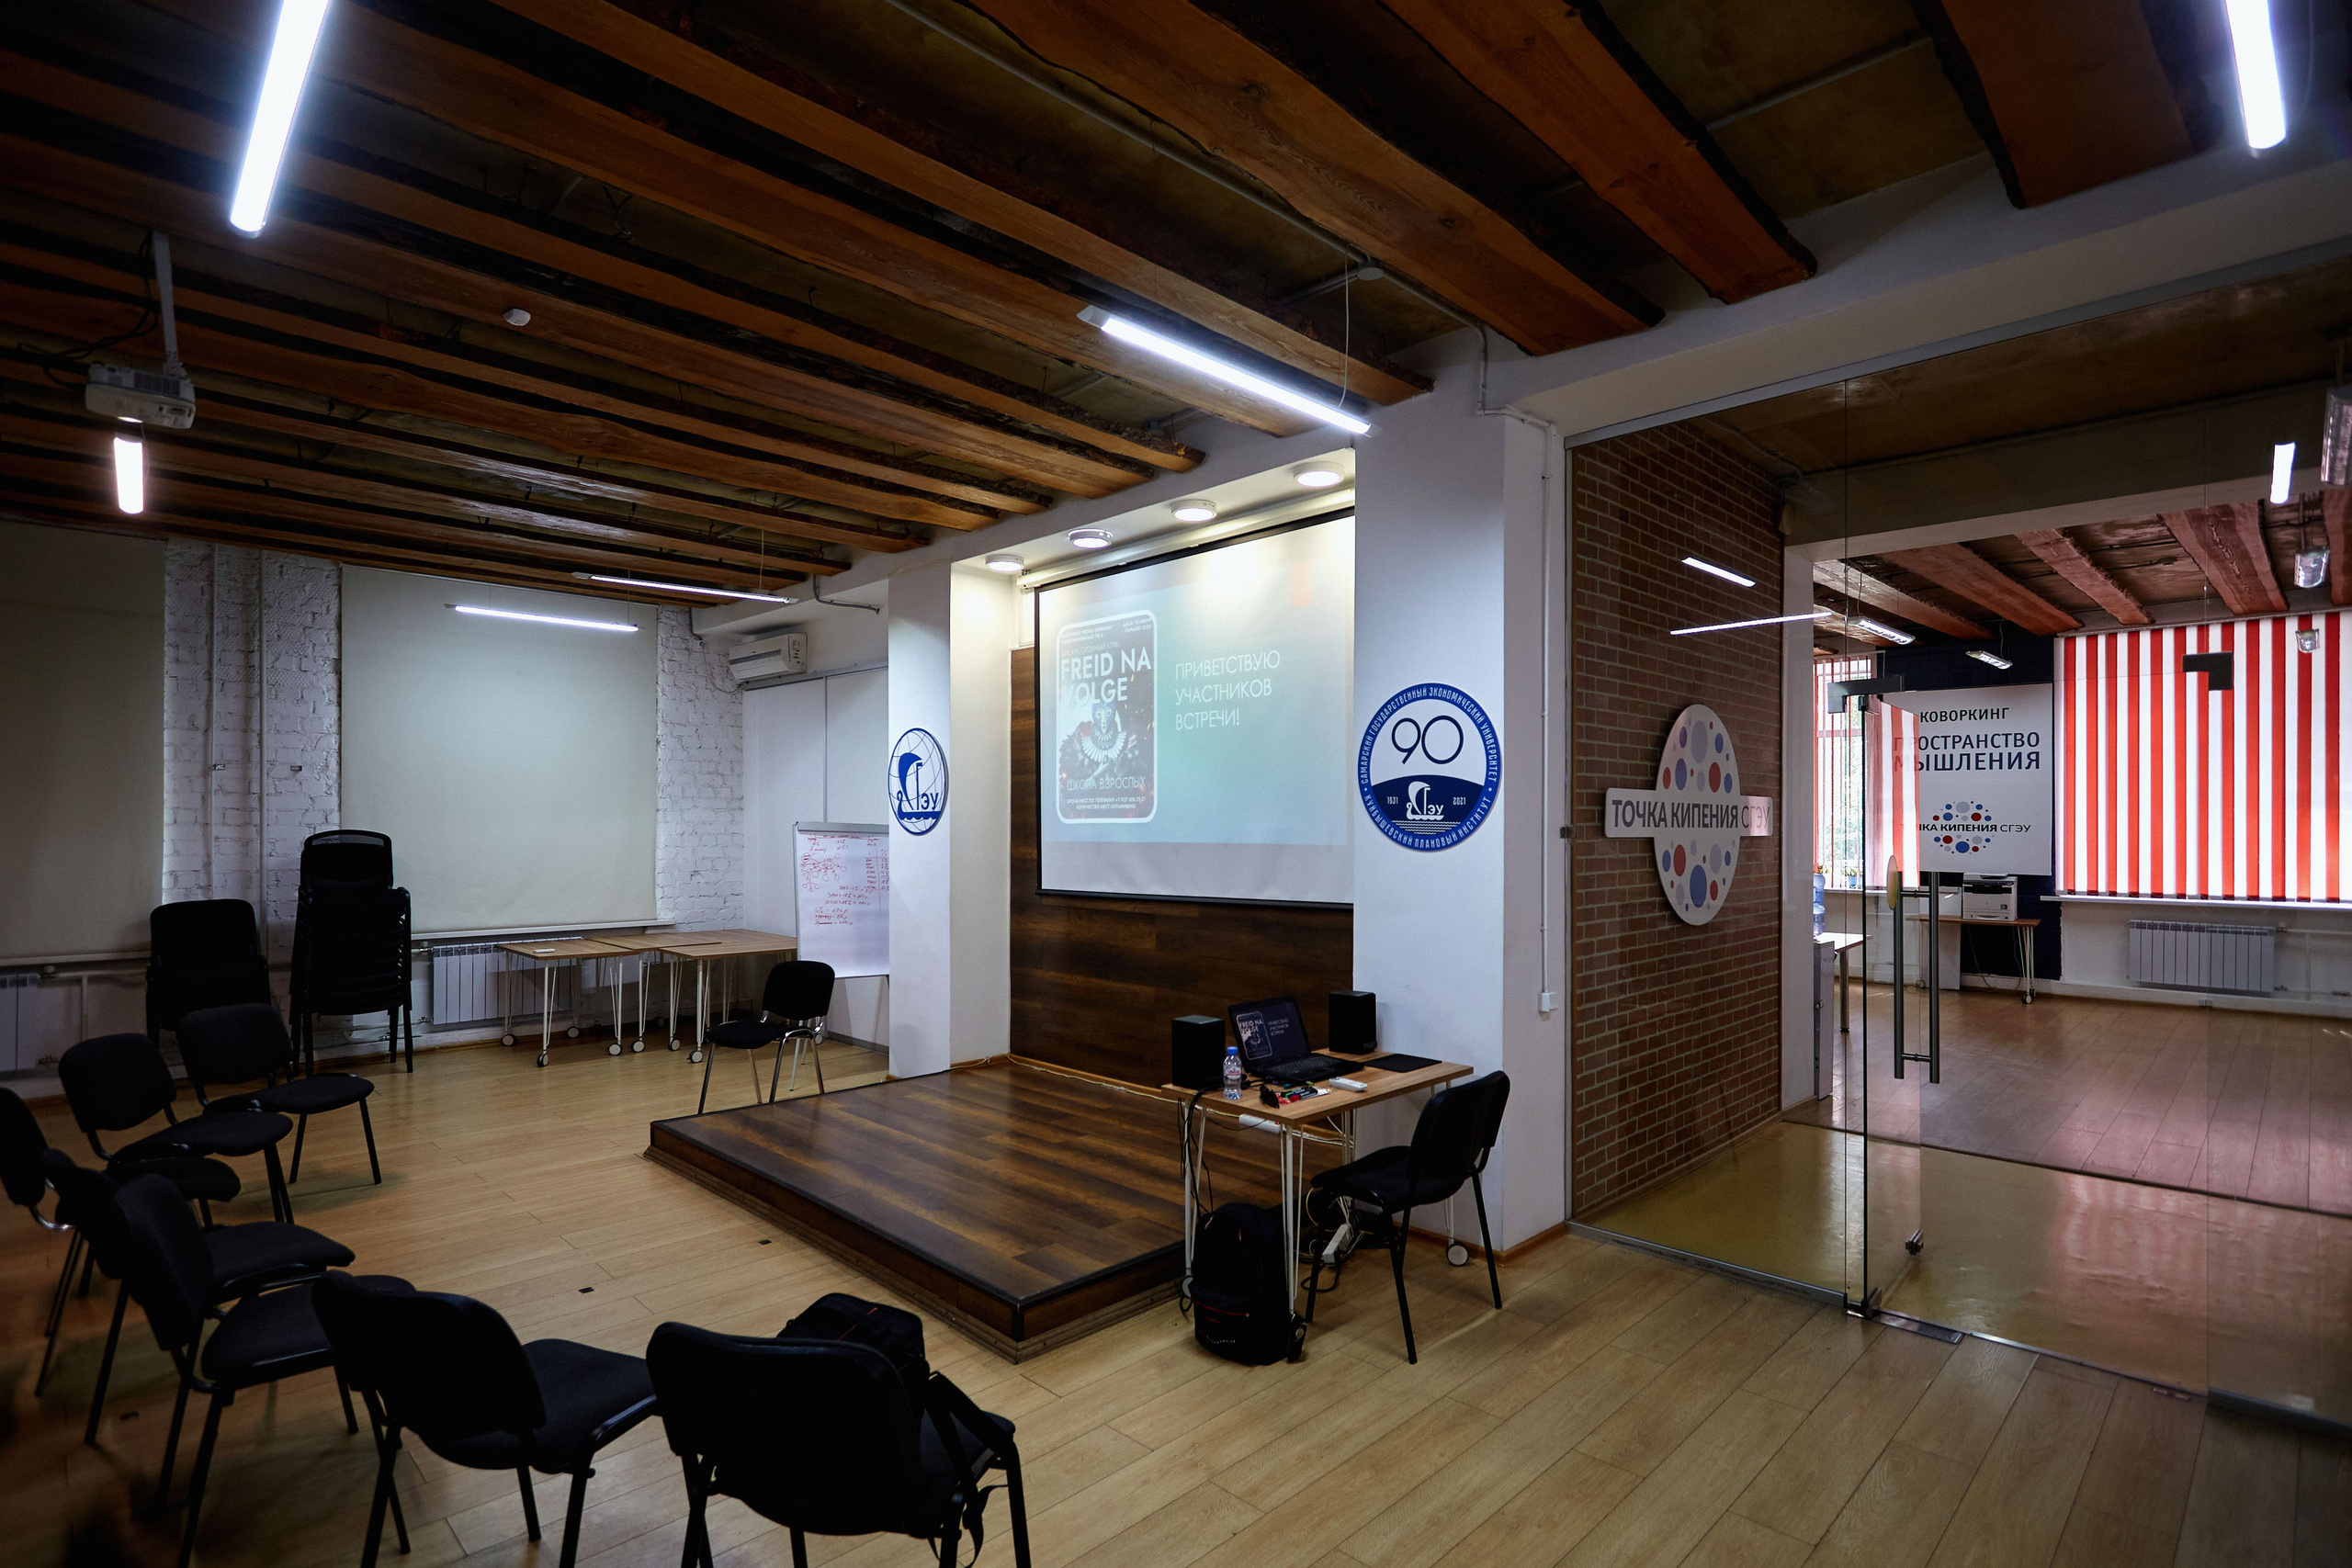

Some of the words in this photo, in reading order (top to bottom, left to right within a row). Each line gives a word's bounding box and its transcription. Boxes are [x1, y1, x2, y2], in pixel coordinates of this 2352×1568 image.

[1061, 651, 1114, 682] FREID
[1121, 646, 1152, 673] NA
[1175, 649, 1281, 680] ПРИВЕТСТВУЮ
[1175, 678, 1272, 705] УЧАСТНИКОВ
[1175, 707, 1239, 730] ВСТРЕЧИ!
[1919, 707, 2009, 723] КОВОРКИНГ
[1360, 735, 1374, 784] САМАРСКИЙ
[1369, 685, 1428, 736] ГОСУДАРСТВЕННЫЙ
[1429, 686, 1486, 725] ЭКОНОМИЧЕСКИЙ
[1480, 722, 1498, 783] УНИВЕРСИТЕТ
[1391, 715, 1464, 765] 90
[1894, 732, 2041, 751] ОСТРАНСТВО
[1386, 796, 1398, 805] 1931
[1453, 796, 1466, 806] 2021
[1611, 799, 1668, 829] ТОЧКА
[1671, 802, 1738, 829] КИПЕНИЯ
[1741, 805, 1770, 829] СГЭУ
[1363, 794, 1413, 846] КУЙБЫШЕВСКИЙ
[1415, 832, 1458, 849] ПЛАНОВЫЙ
[1457, 795, 1491, 838] ИНСТИТУТ
[1940, 824, 1997, 832] КИПЕНИЯ
[2000, 824, 2031, 832] СГЭУ
